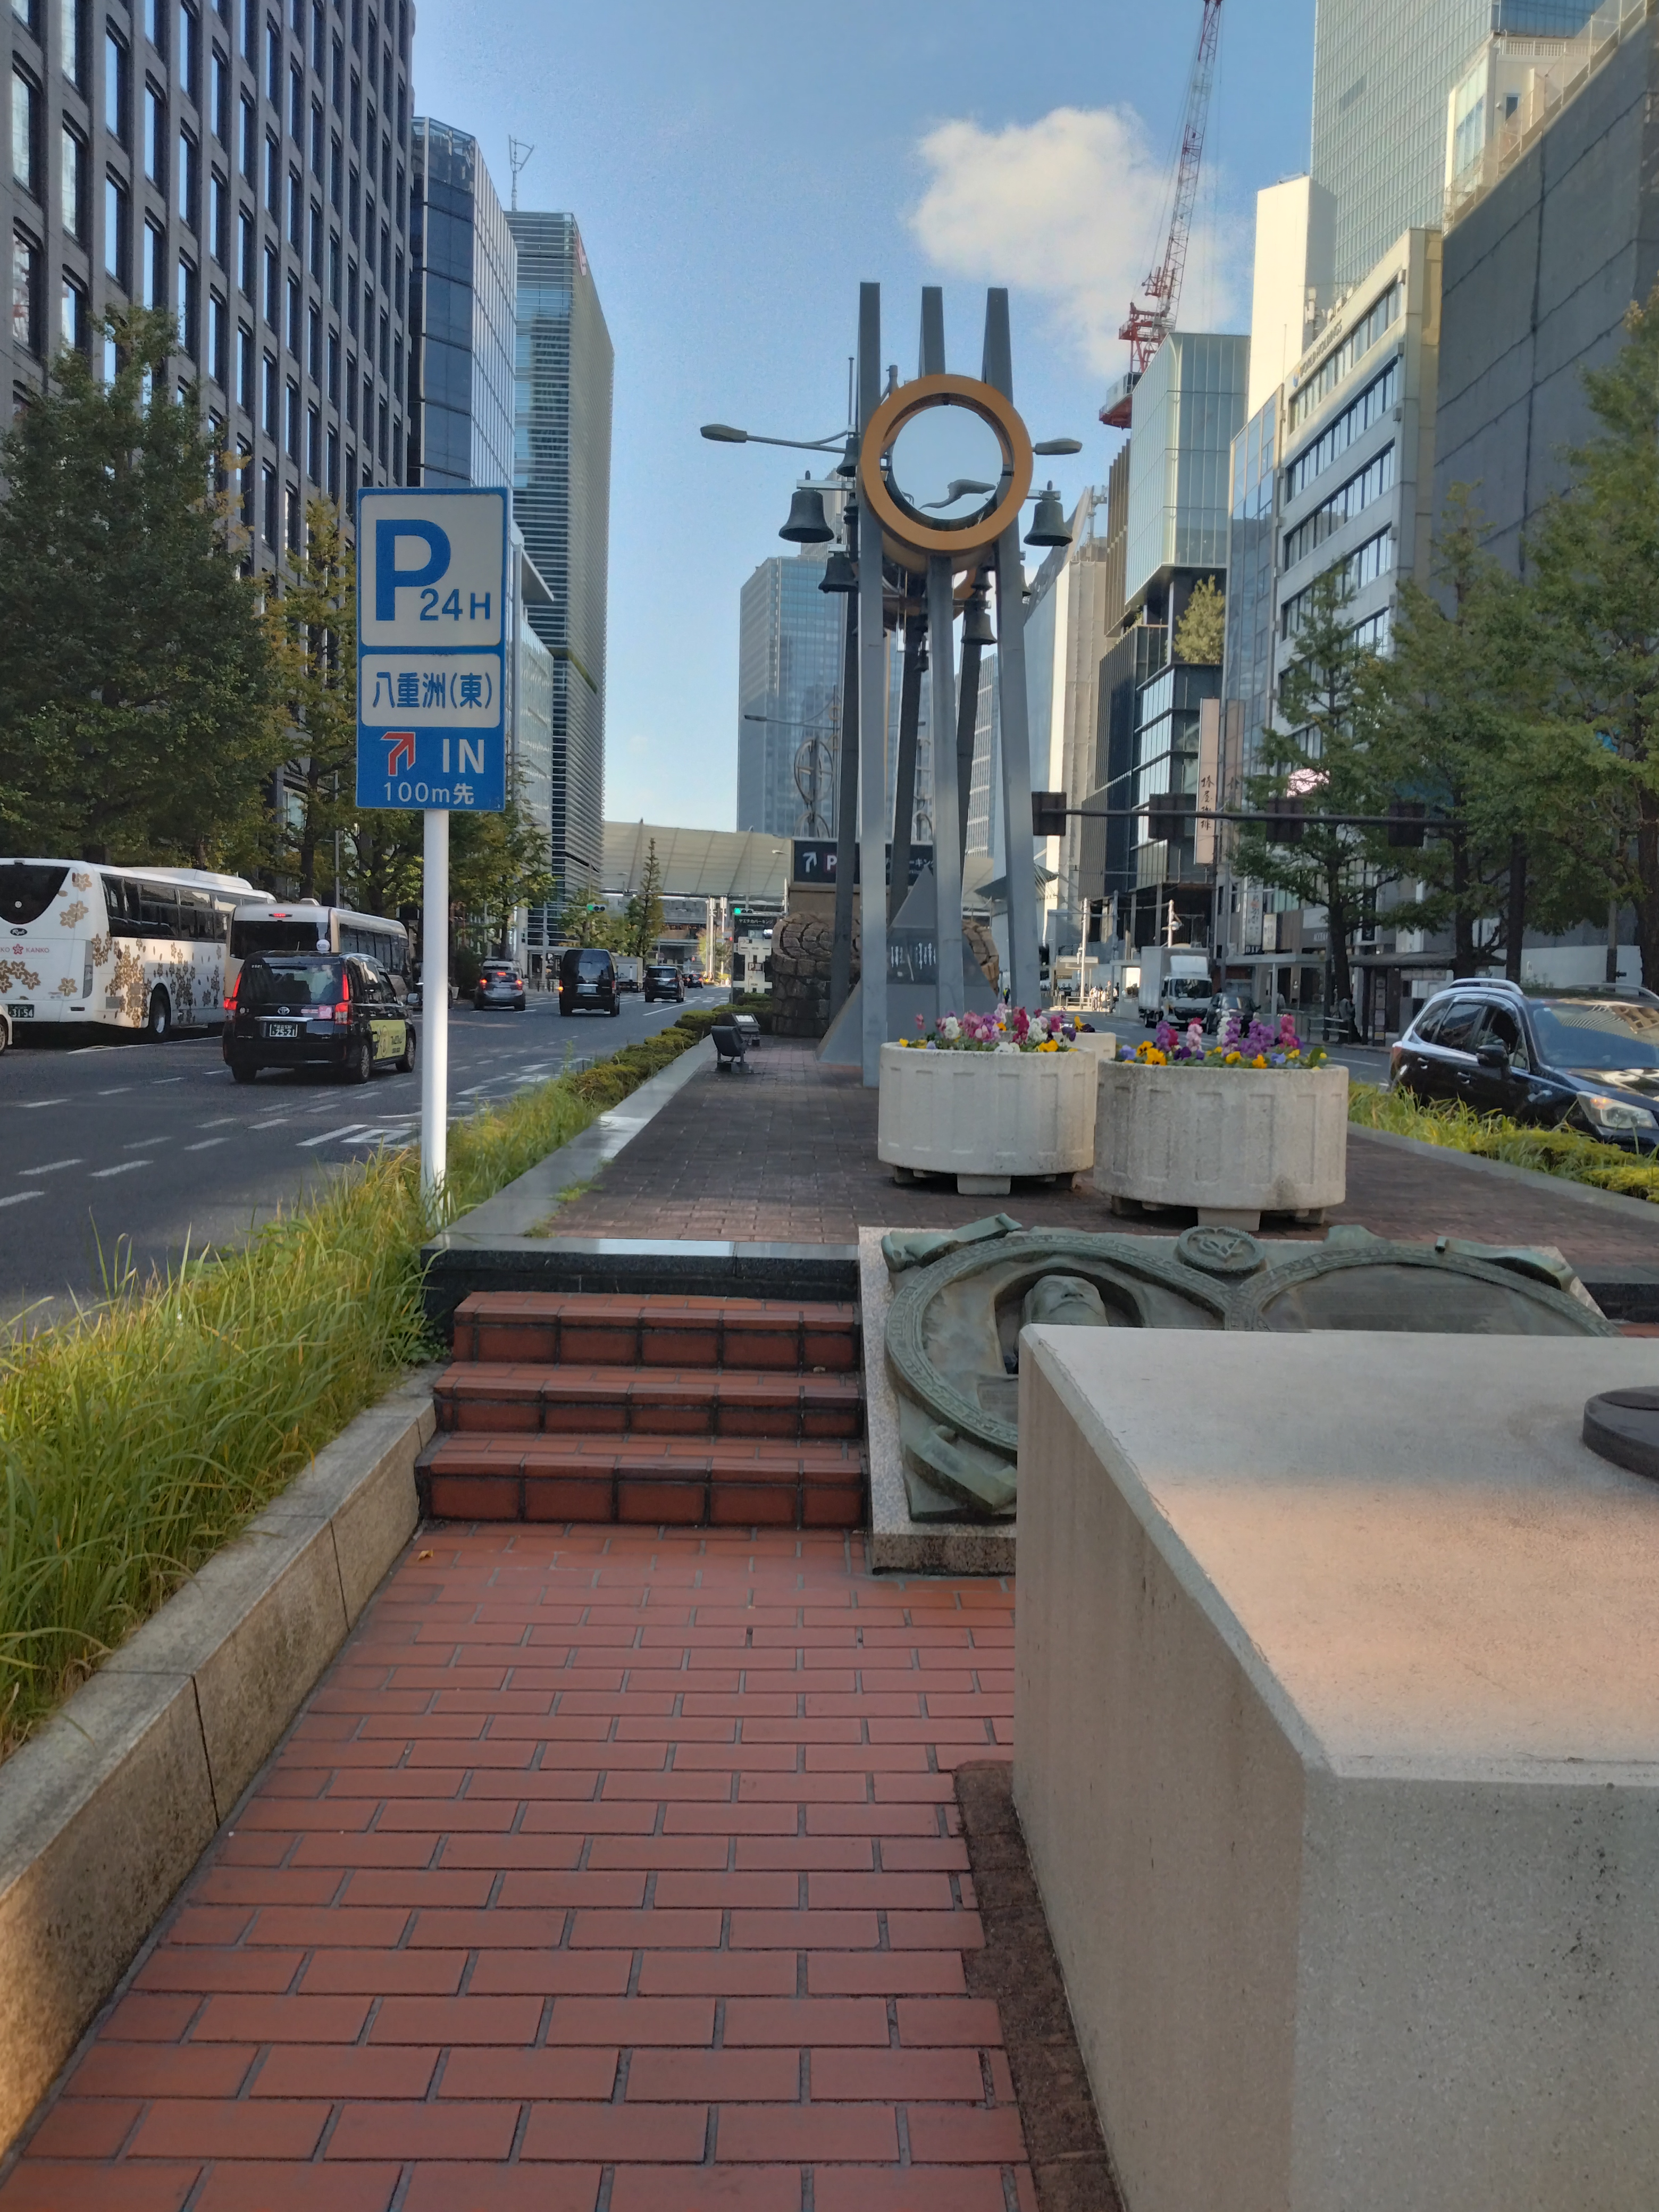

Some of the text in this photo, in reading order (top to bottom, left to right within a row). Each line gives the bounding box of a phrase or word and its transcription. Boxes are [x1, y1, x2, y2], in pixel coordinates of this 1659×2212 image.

[375, 520, 491, 621] P 24H
[372, 671, 492, 709] 八重洲(東)
[442, 738, 485, 774] IN
[383, 781, 475, 805] 100m先
